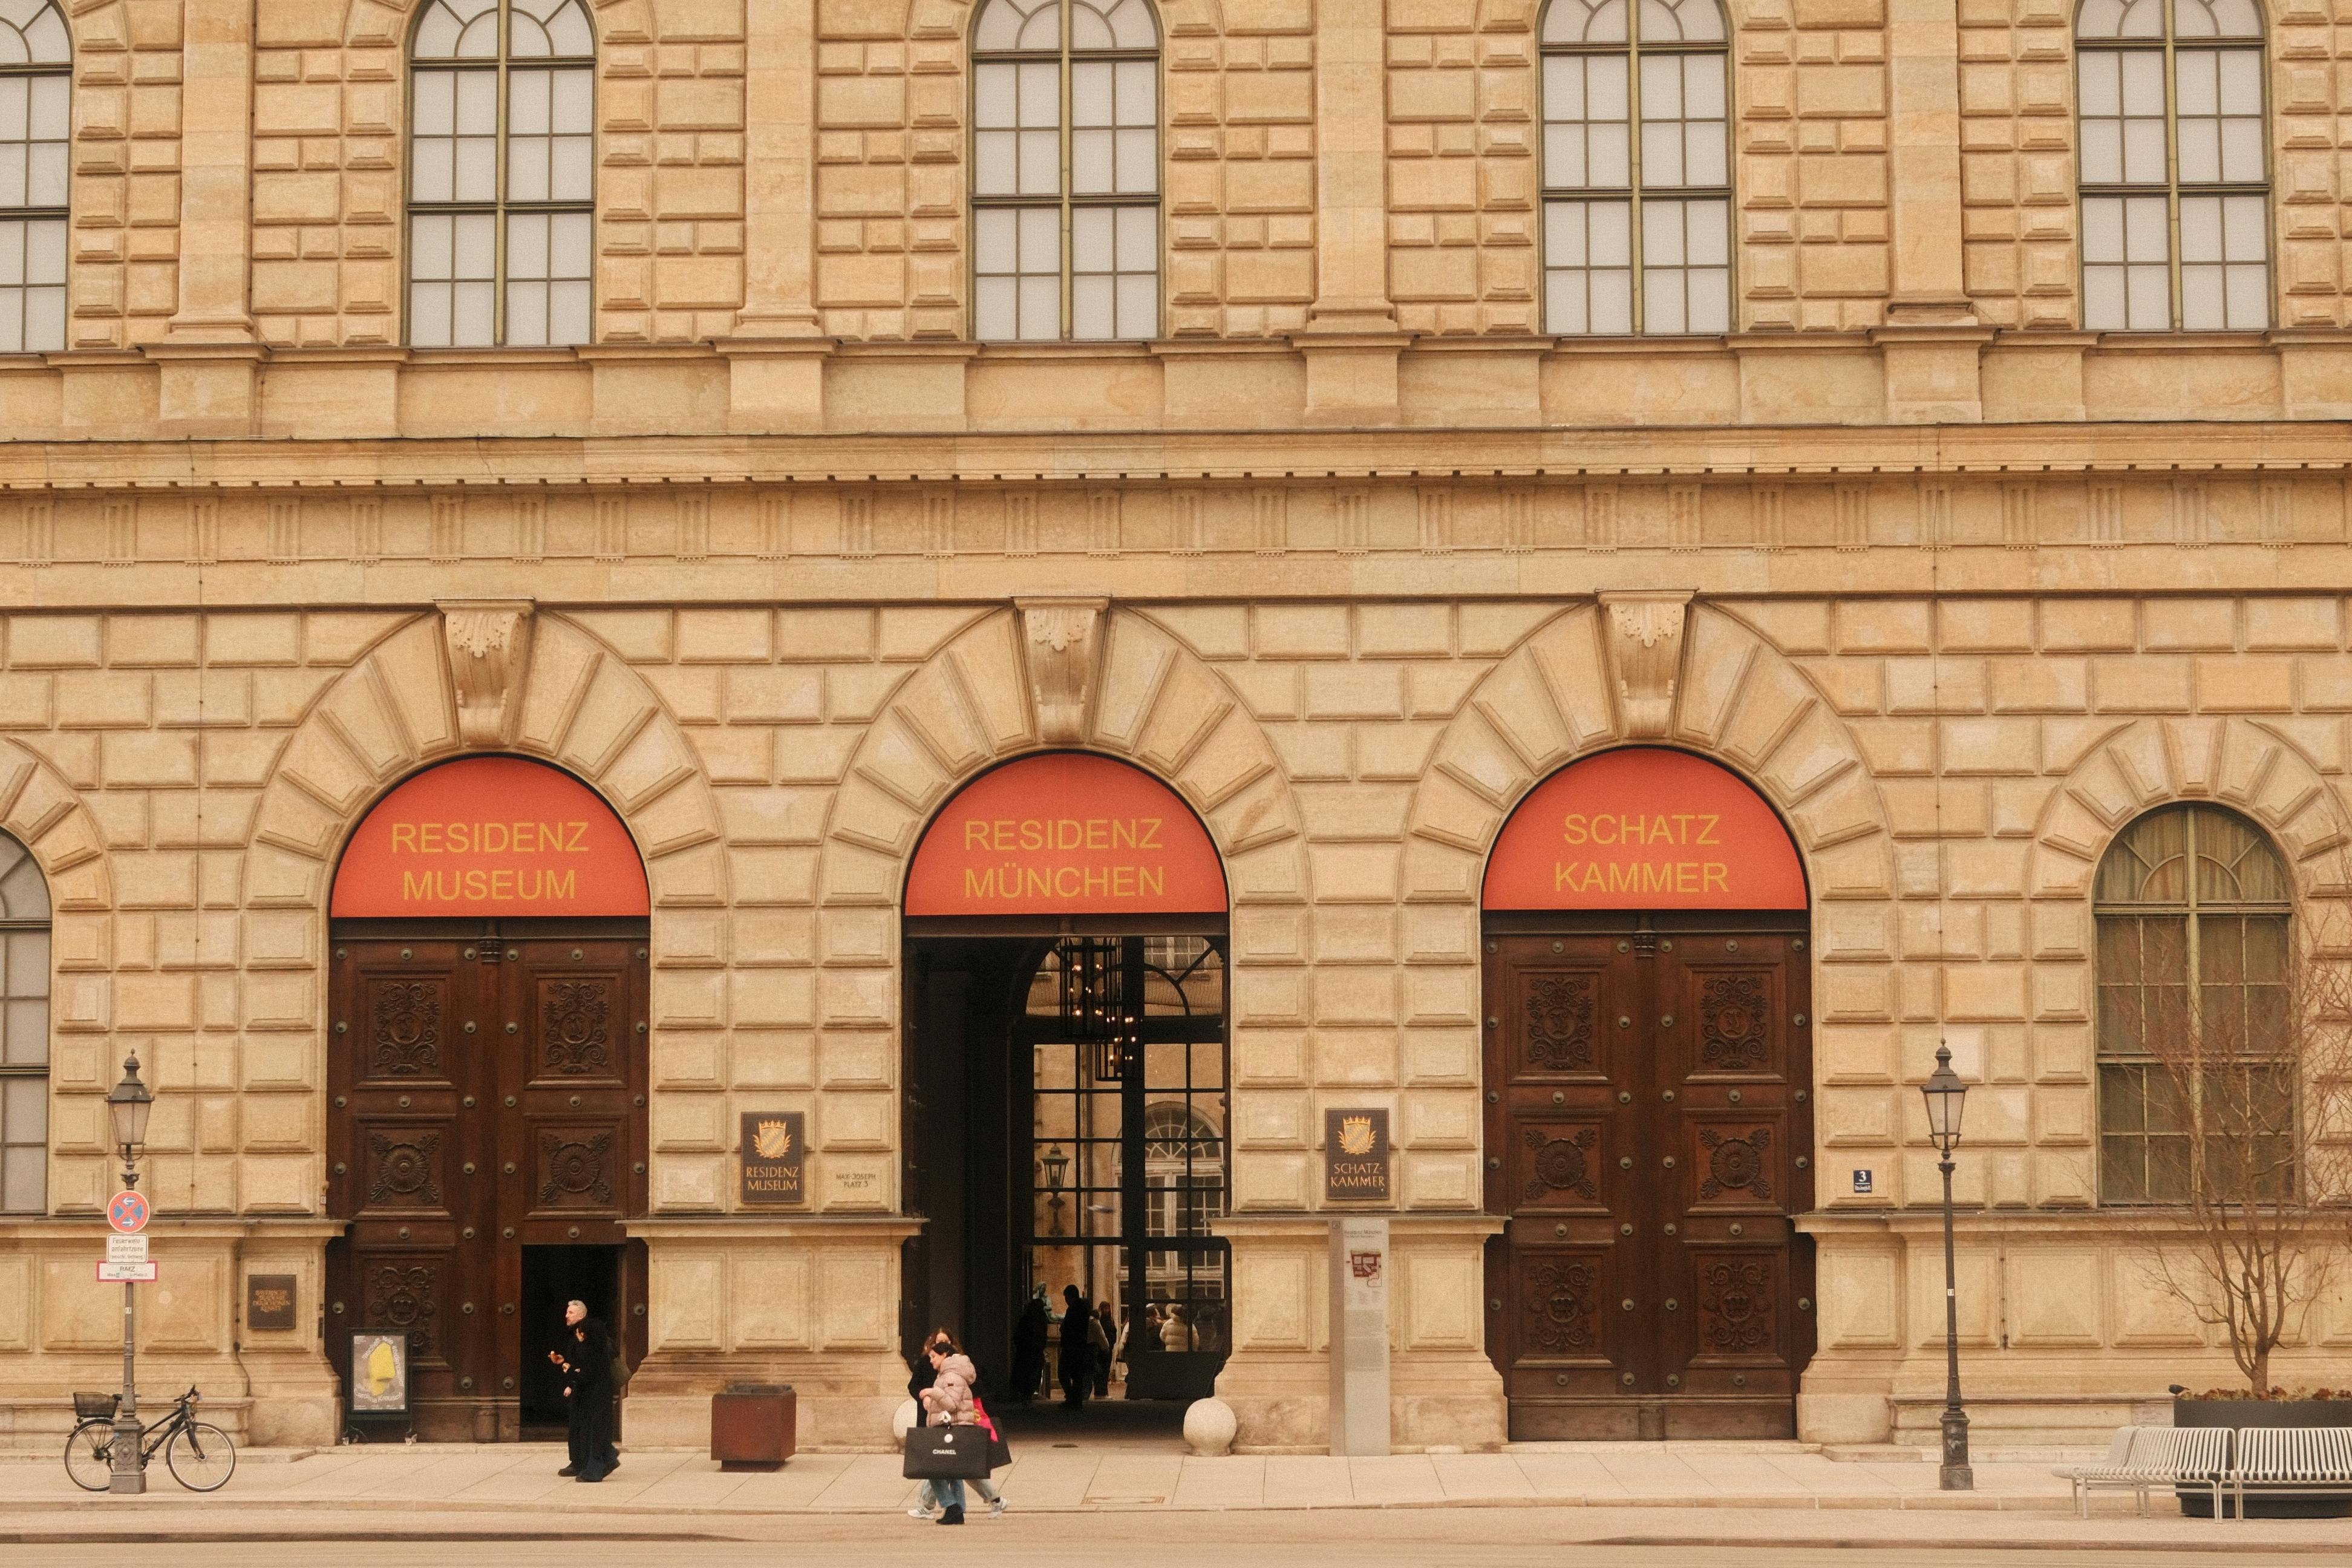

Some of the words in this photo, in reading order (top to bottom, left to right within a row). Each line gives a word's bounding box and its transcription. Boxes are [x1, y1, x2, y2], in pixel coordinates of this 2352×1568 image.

[392, 822, 589, 854] RESIDENZ
[965, 818, 1163, 851] RESIDENZ
[1564, 814, 1720, 845] SCHATZ
[403, 869, 575, 901] MUSEUM
[965, 862, 1164, 898] MÜNCHEN
[1555, 861, 1729, 892] KAMMER
[746, 1166, 799, 1178] RESIDENZ
[1331, 1176, 1385, 1187] KAMMER
[1334, 1163, 1383, 1174] SCHATZ-
[1858, 1171, 1867, 1182] 3
[747, 1180, 798, 1191] MUSEUM
